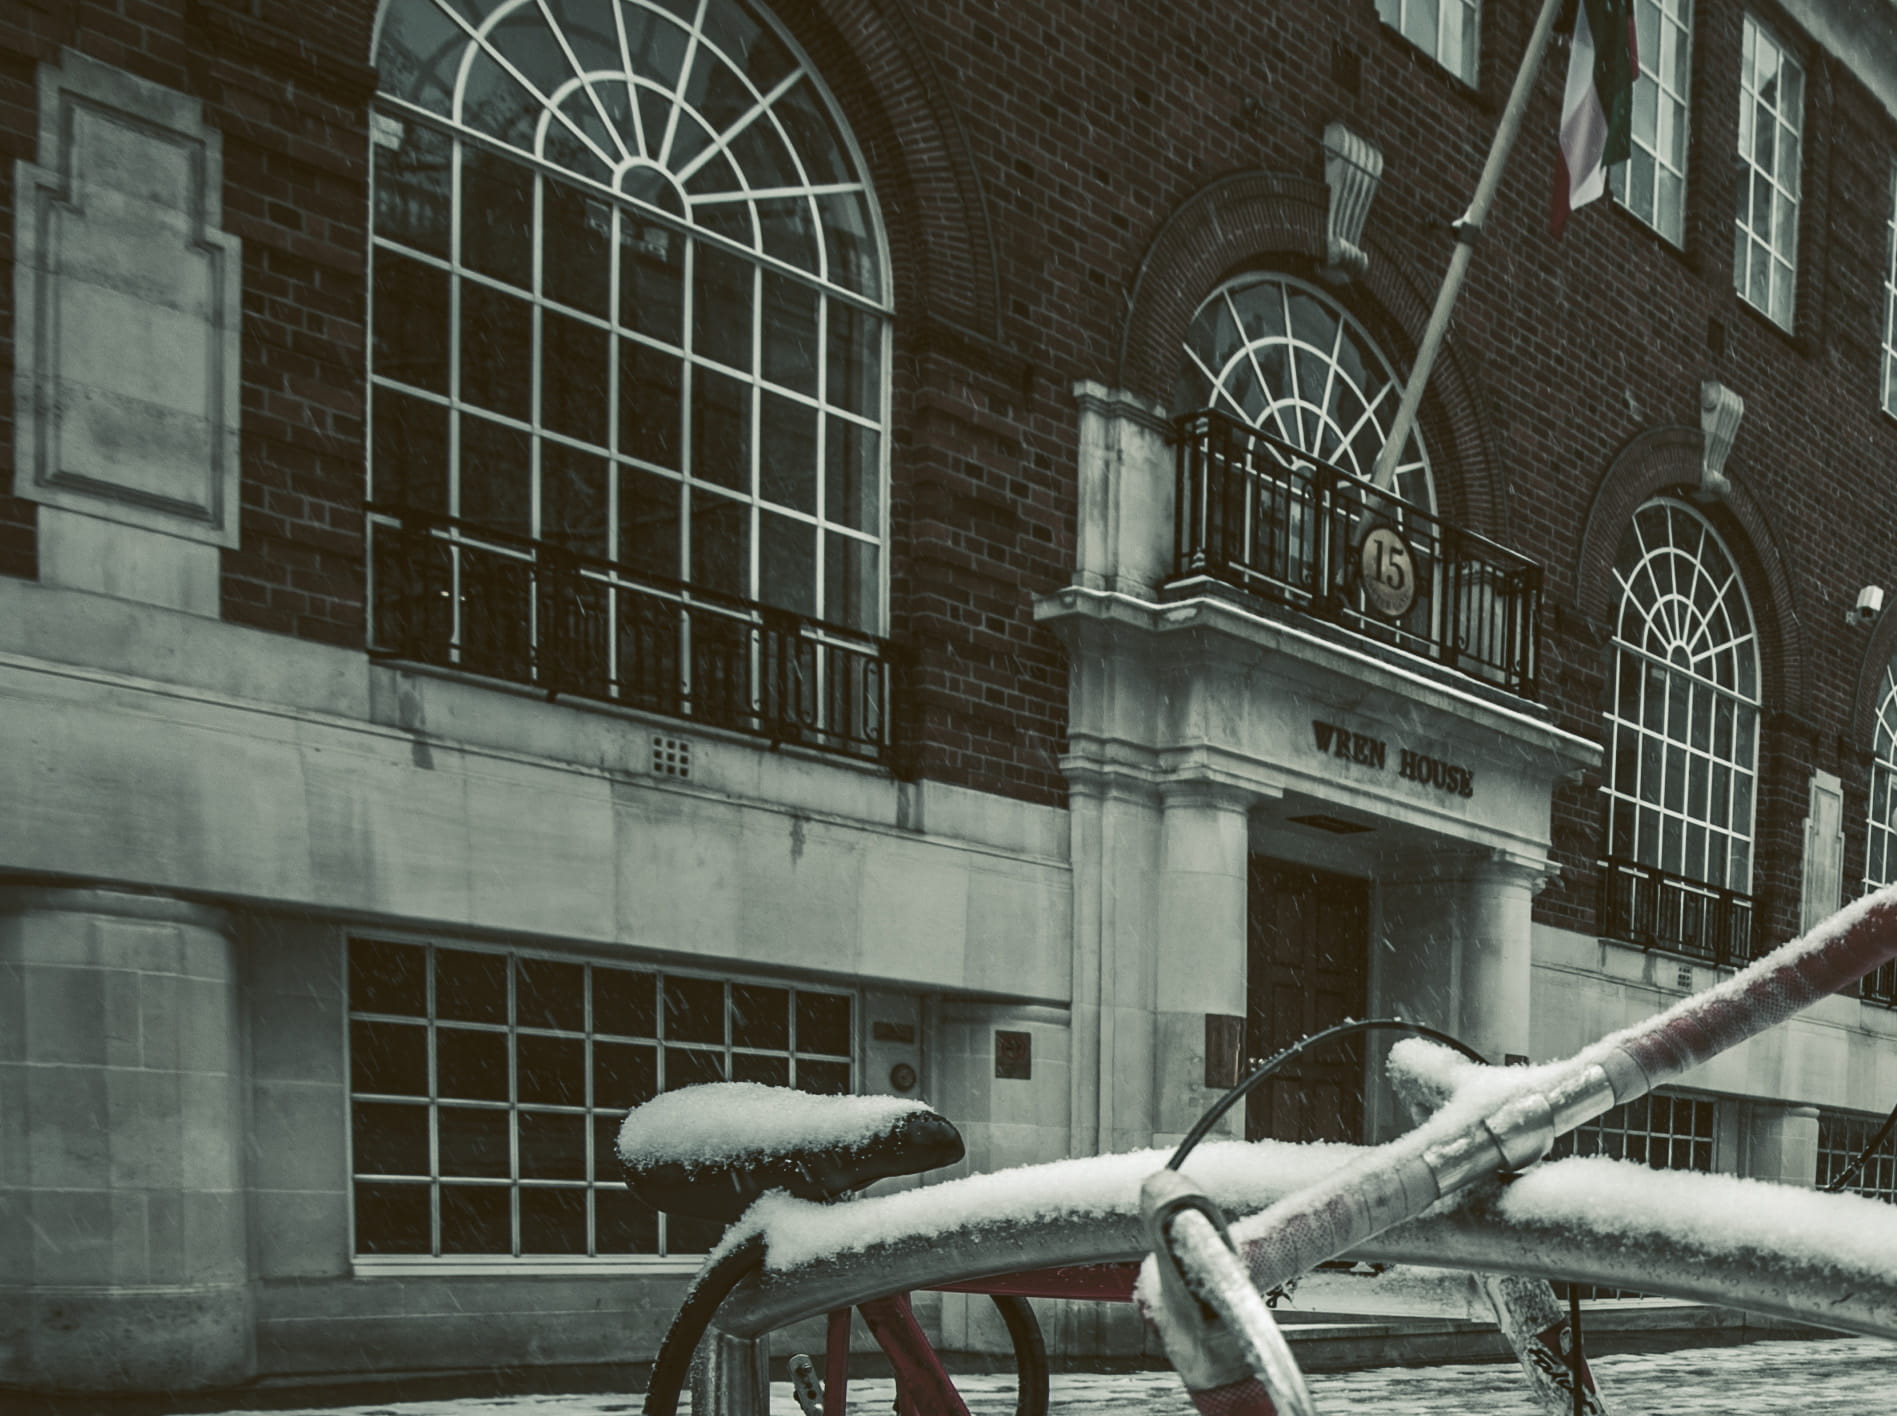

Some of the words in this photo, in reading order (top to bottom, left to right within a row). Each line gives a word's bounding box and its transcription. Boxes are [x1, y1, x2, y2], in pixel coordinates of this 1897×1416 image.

[1373, 538, 1405, 591] 15
[1312, 719, 1387, 770] WREN
[1399, 747, 1475, 799] HOUSE
